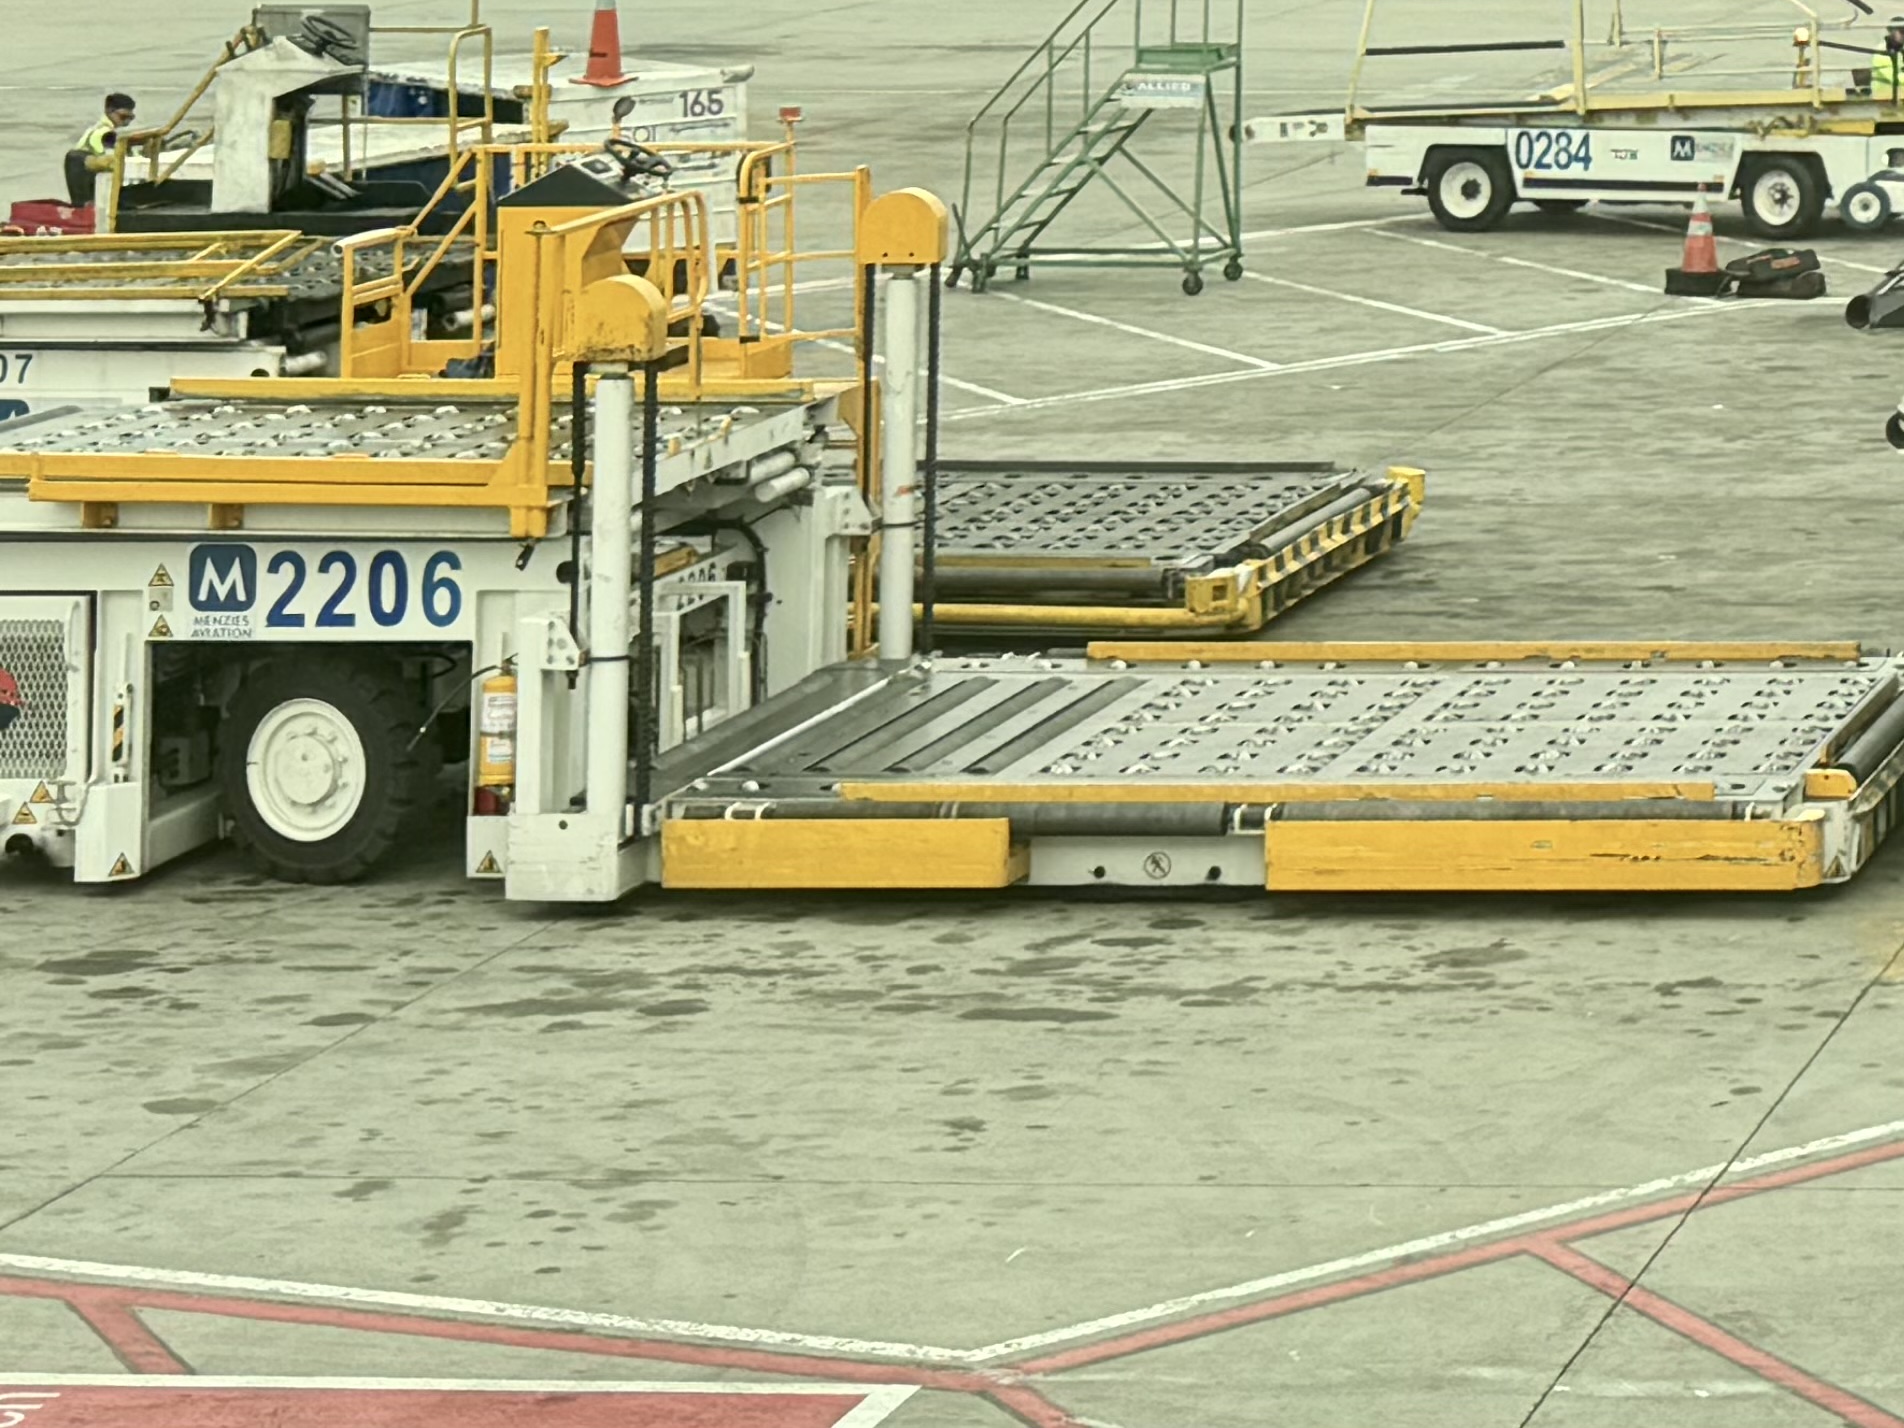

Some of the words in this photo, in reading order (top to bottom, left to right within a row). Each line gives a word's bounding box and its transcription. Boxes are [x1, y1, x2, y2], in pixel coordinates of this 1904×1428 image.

[679, 89, 725, 118] 165
[1515, 131, 1593, 172] 0284
[264, 549, 463, 628] 2206
